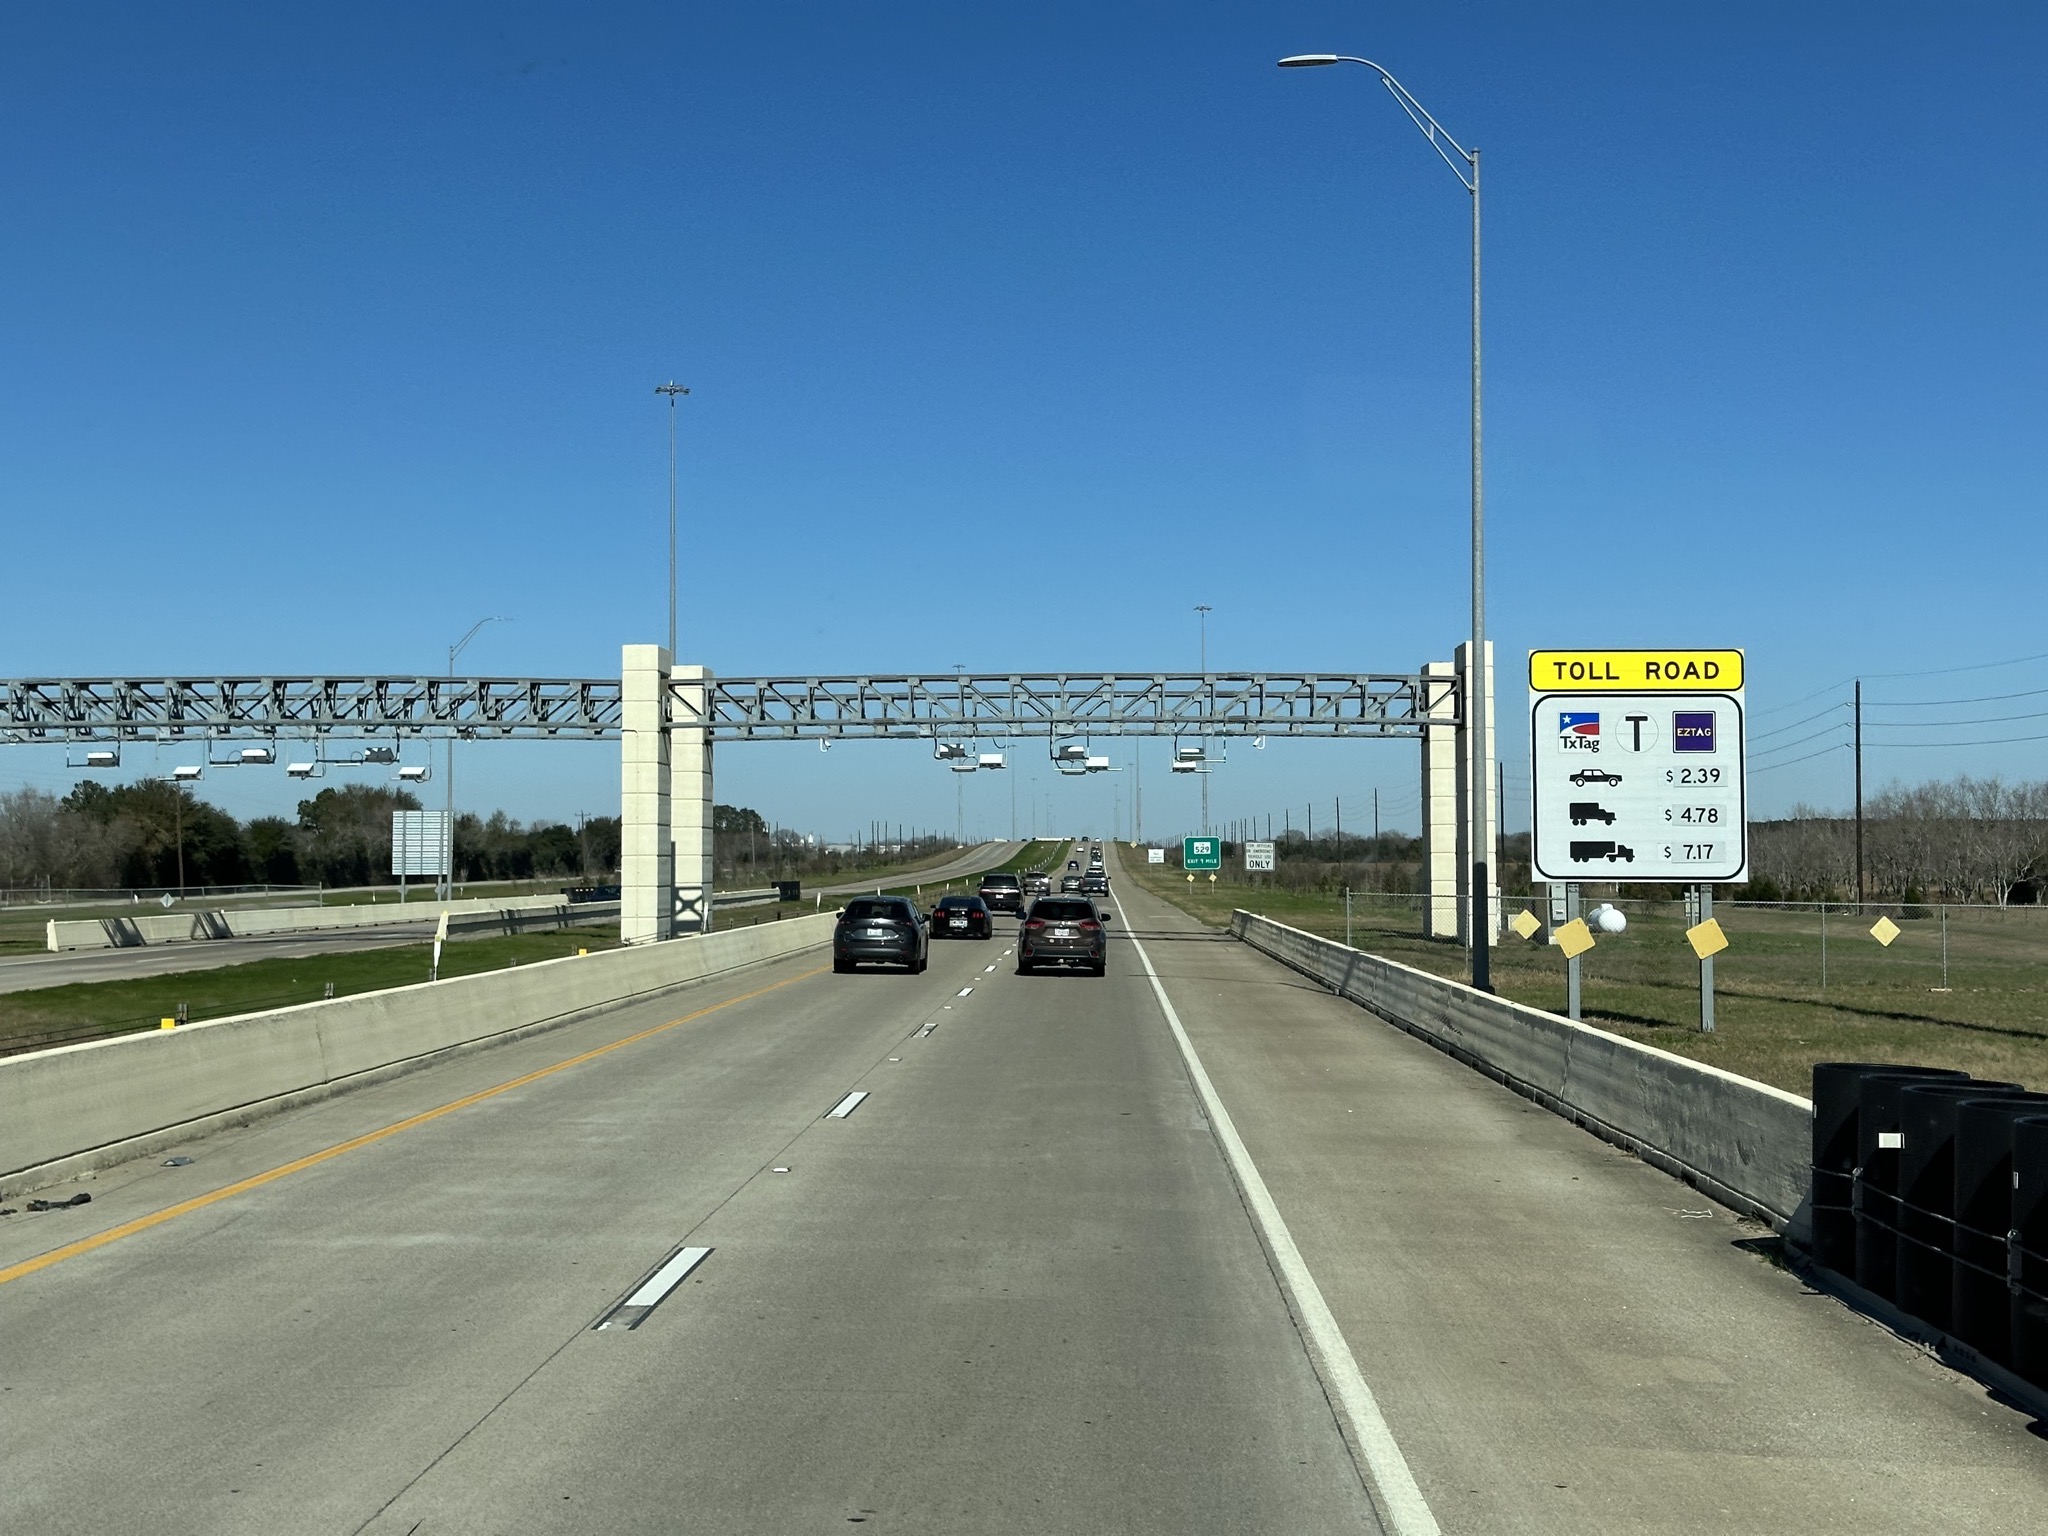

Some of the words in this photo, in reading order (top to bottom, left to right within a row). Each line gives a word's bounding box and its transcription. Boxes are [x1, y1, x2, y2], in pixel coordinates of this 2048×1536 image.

[1553, 661, 1620, 680] TOLL
[1645, 661, 1720, 680] ROAD
[1625, 715, 1648, 752] T
[1560, 736, 1600, 753] TxTag
[1680, 768, 1721, 784] 2.39
[1680, 808, 1719, 823] 4.78
[1683, 844, 1714, 860] 7.17
[1249, 859, 1270, 868] ONLY
